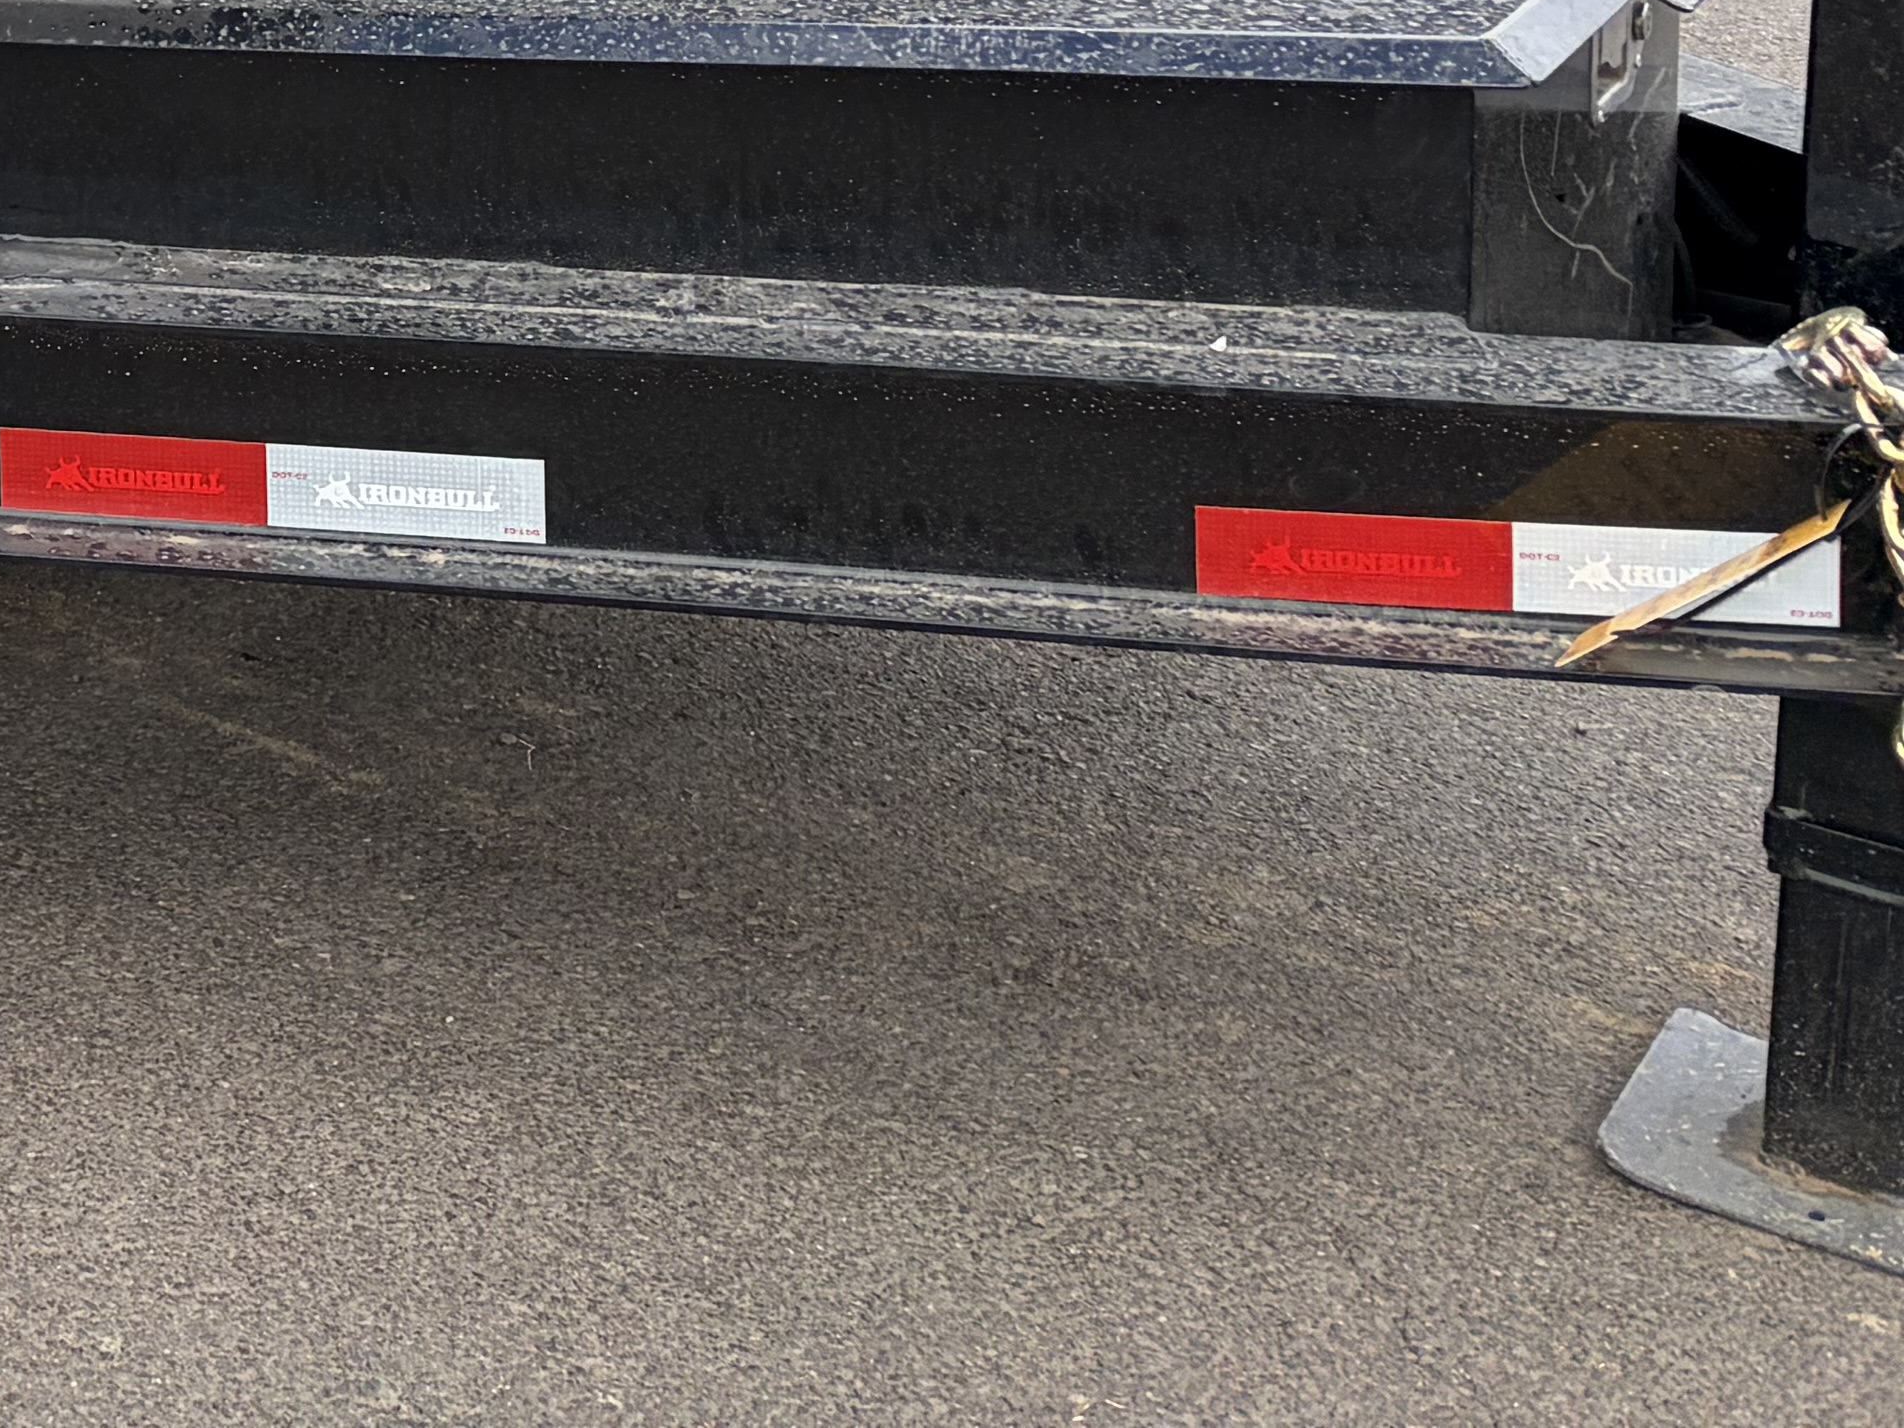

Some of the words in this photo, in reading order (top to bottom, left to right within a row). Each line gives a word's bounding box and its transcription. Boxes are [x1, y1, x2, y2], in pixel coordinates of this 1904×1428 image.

[90, 466, 226, 496] IRONBULL
[358, 483, 500, 512] IRONBULL
[1301, 547, 1463, 580] IRONBULL
